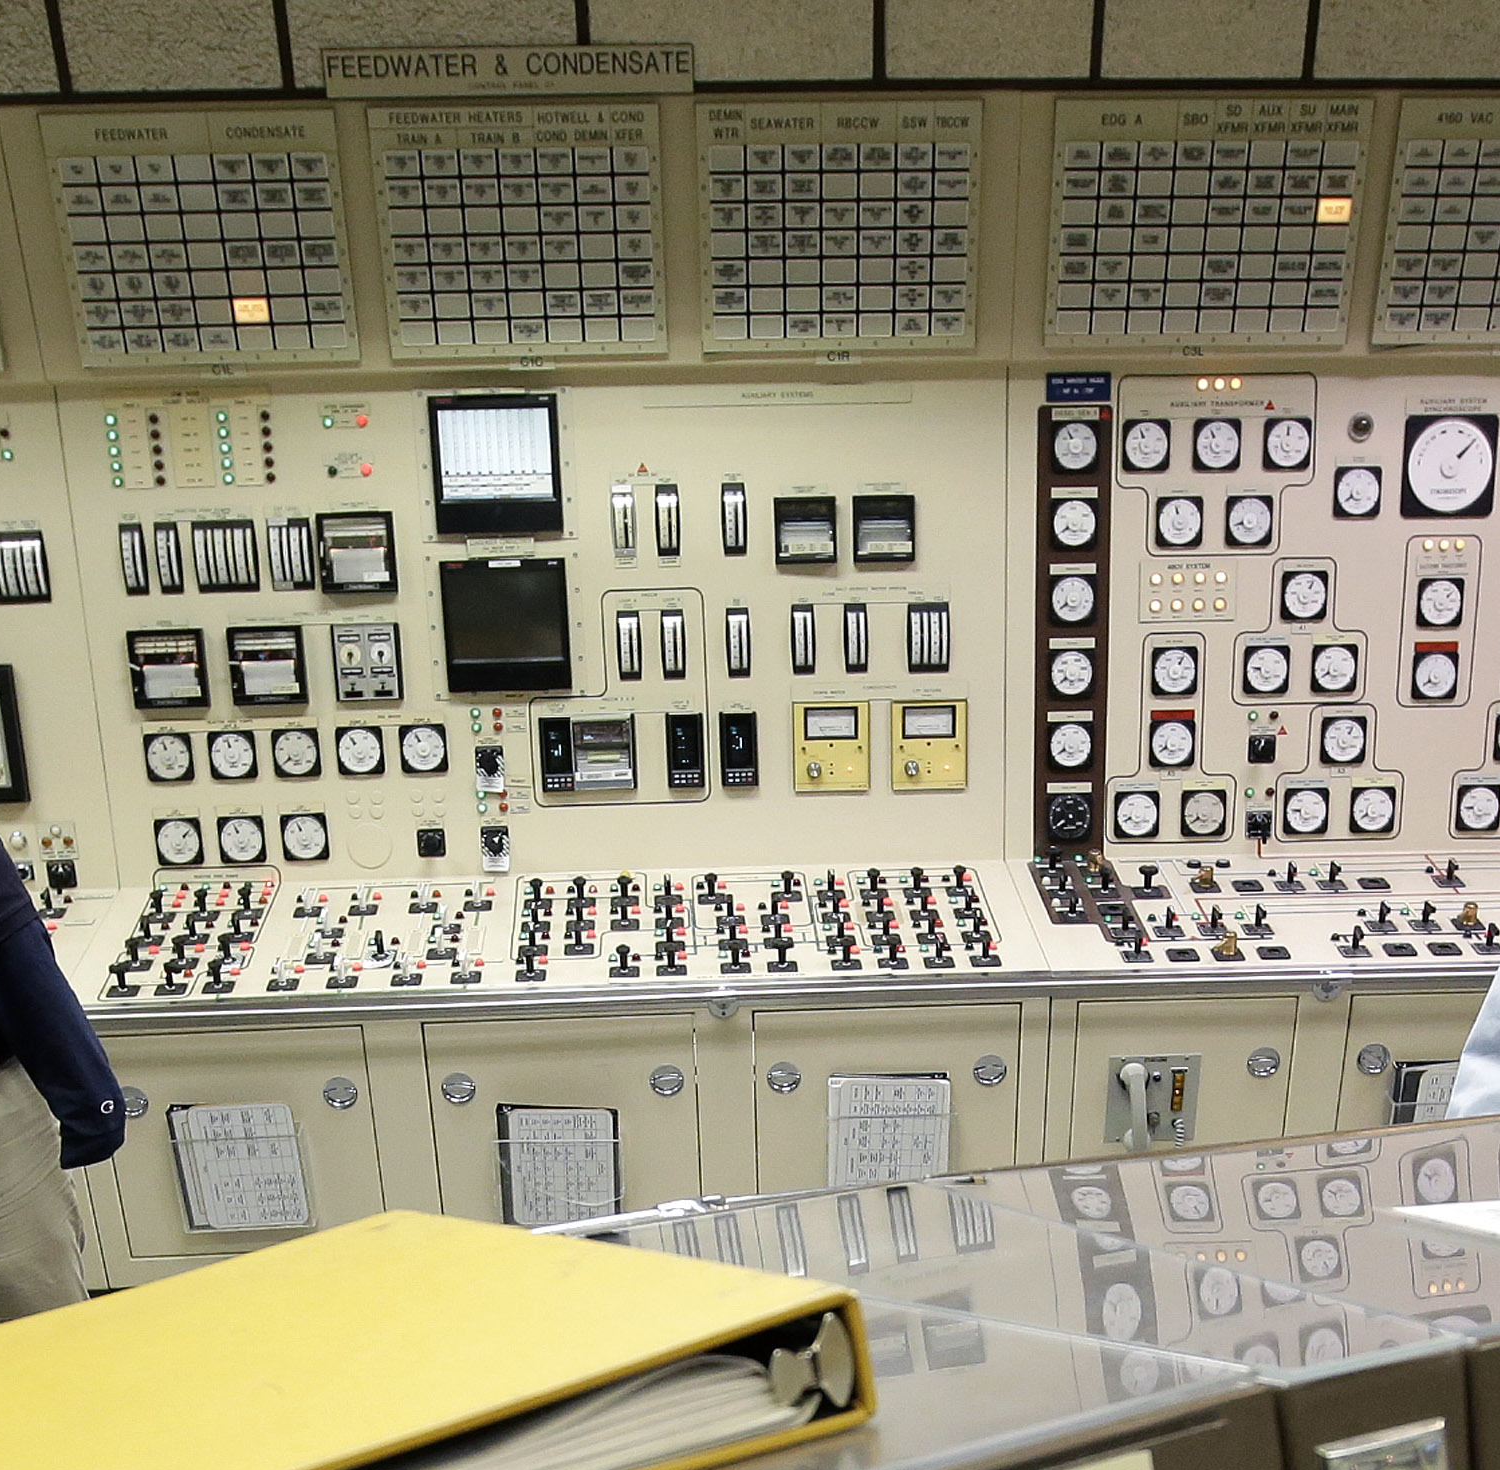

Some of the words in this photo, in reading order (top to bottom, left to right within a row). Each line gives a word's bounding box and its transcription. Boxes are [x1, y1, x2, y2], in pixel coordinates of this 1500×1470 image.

[326, 52, 478, 79] FEEDWATER
[494, 52, 510, 75] &
[525, 50, 691, 77] CONDENSATE
[611, 110, 645, 123] COND
[708, 109, 743, 122] DEMIN
[1226, 103, 1243, 117] SD
[1258, 103, 1283, 116] AUX
[1299, 103, 1316, 117] SU
[1329, 103, 1359, 117] MAIN
[388, 111, 461, 124] FEEDWATER
[467, 110, 523, 124] HEATERS
[537, 111, 592, 124] HOTWELL
[597, 111, 605, 122] &
[750, 116, 814, 130] SEAWATER
[836, 115, 880, 129] RBCCW
[901, 116, 927, 129] SSW
[936, 115, 970, 129] TBCCW
[1101, 113, 1126, 126] EDG
[1134, 113, 1143, 126] A
[1183, 113, 1208, 127] SBO
[1437, 112, 1463, 125] 4160
[1470, 111, 1495, 125] VAC
[224, 125, 306, 138] CONDENSATE
[713, 126, 739, 140] WTR
[1217, 120, 1249, 134] XFMR
[1253, 120, 1286, 134] XFMR
[1290, 120, 1322, 134] XFMR
[1326, 120, 1359, 133] XFMR
[94, 127, 168, 141] FEEDWATER
[396, 132, 429, 144] TRAIN
[434, 132, 442, 144] A
[470, 131, 502, 144] TRAIN
[511, 131, 520, 143] B
[536, 129, 569, 142] COND
[574, 129, 609, 142] DEMIN
[614, 128, 644, 142] XFER
[826, 350, 850, 362] C1R
[1182, 345, 1204, 358] C3L
[509, 355, 534, 367] C1C
